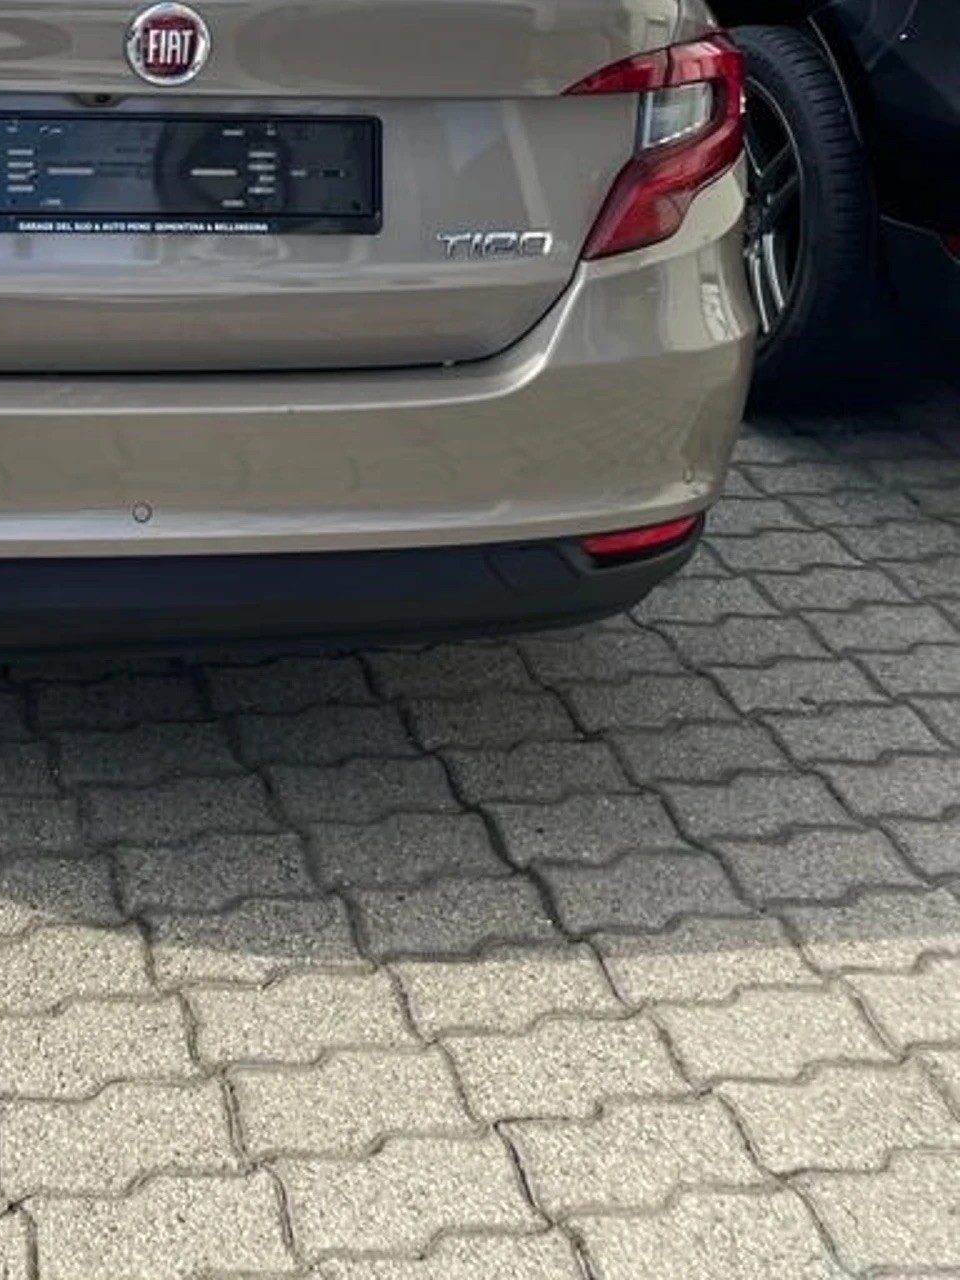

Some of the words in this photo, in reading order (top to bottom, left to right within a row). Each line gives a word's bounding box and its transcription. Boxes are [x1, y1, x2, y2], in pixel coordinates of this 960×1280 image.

[147, 29, 194, 65] FIAT
[56, 222, 72, 231] DEL
[437, 230, 554, 257] TIPO
